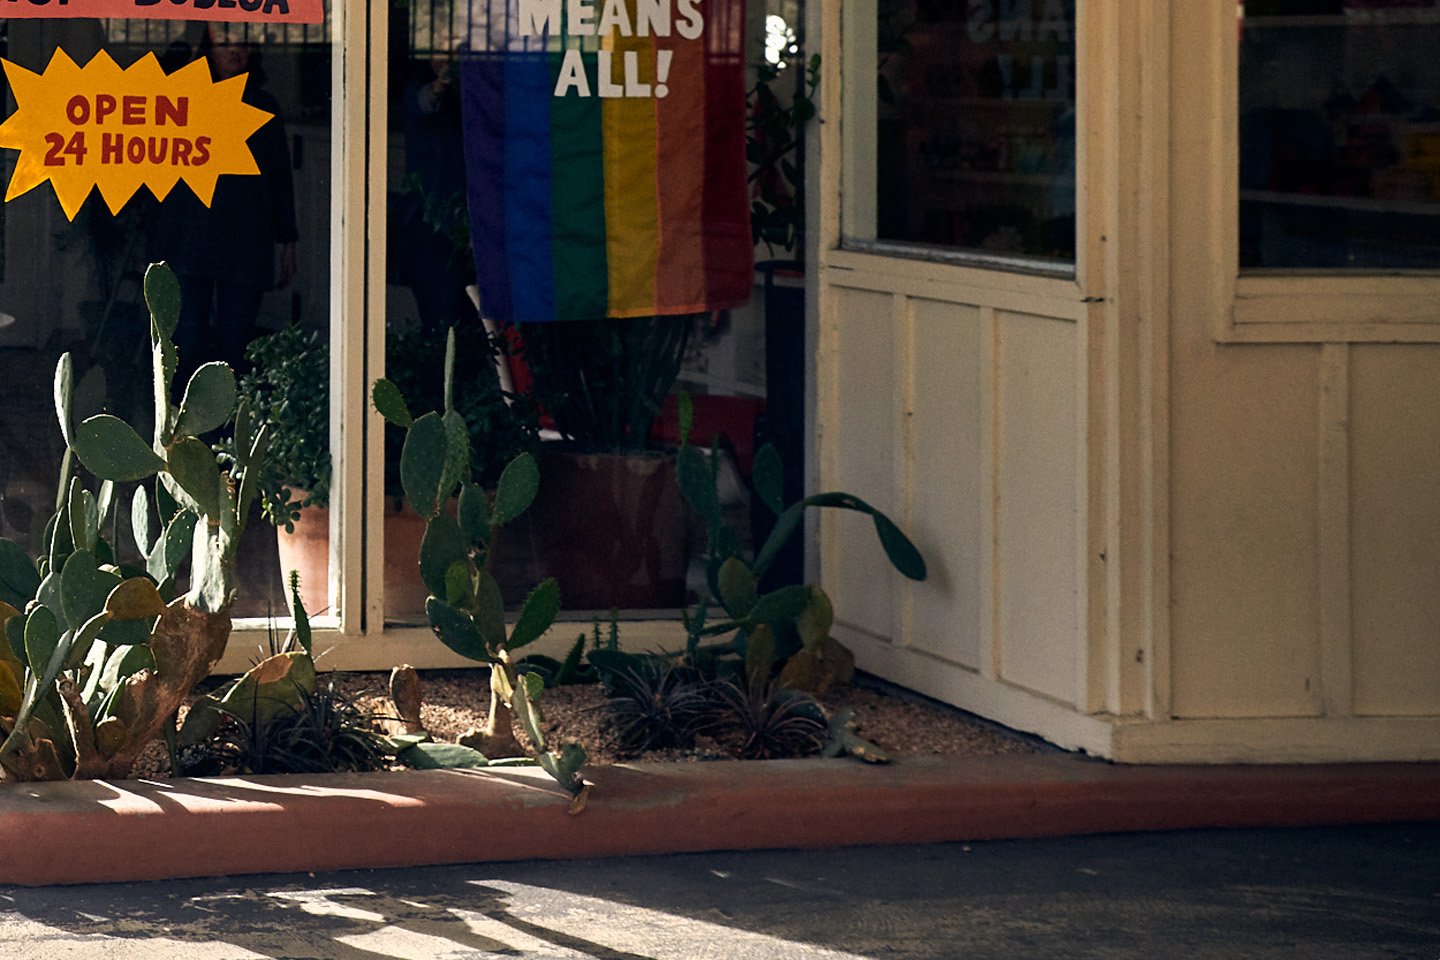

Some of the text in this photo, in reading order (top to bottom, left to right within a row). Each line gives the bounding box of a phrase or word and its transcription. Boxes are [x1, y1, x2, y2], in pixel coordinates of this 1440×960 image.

[554, 49, 674, 99] ALL!
[66, 94, 189, 127] OPEN
[44, 131, 212, 167] 24 HOURS
